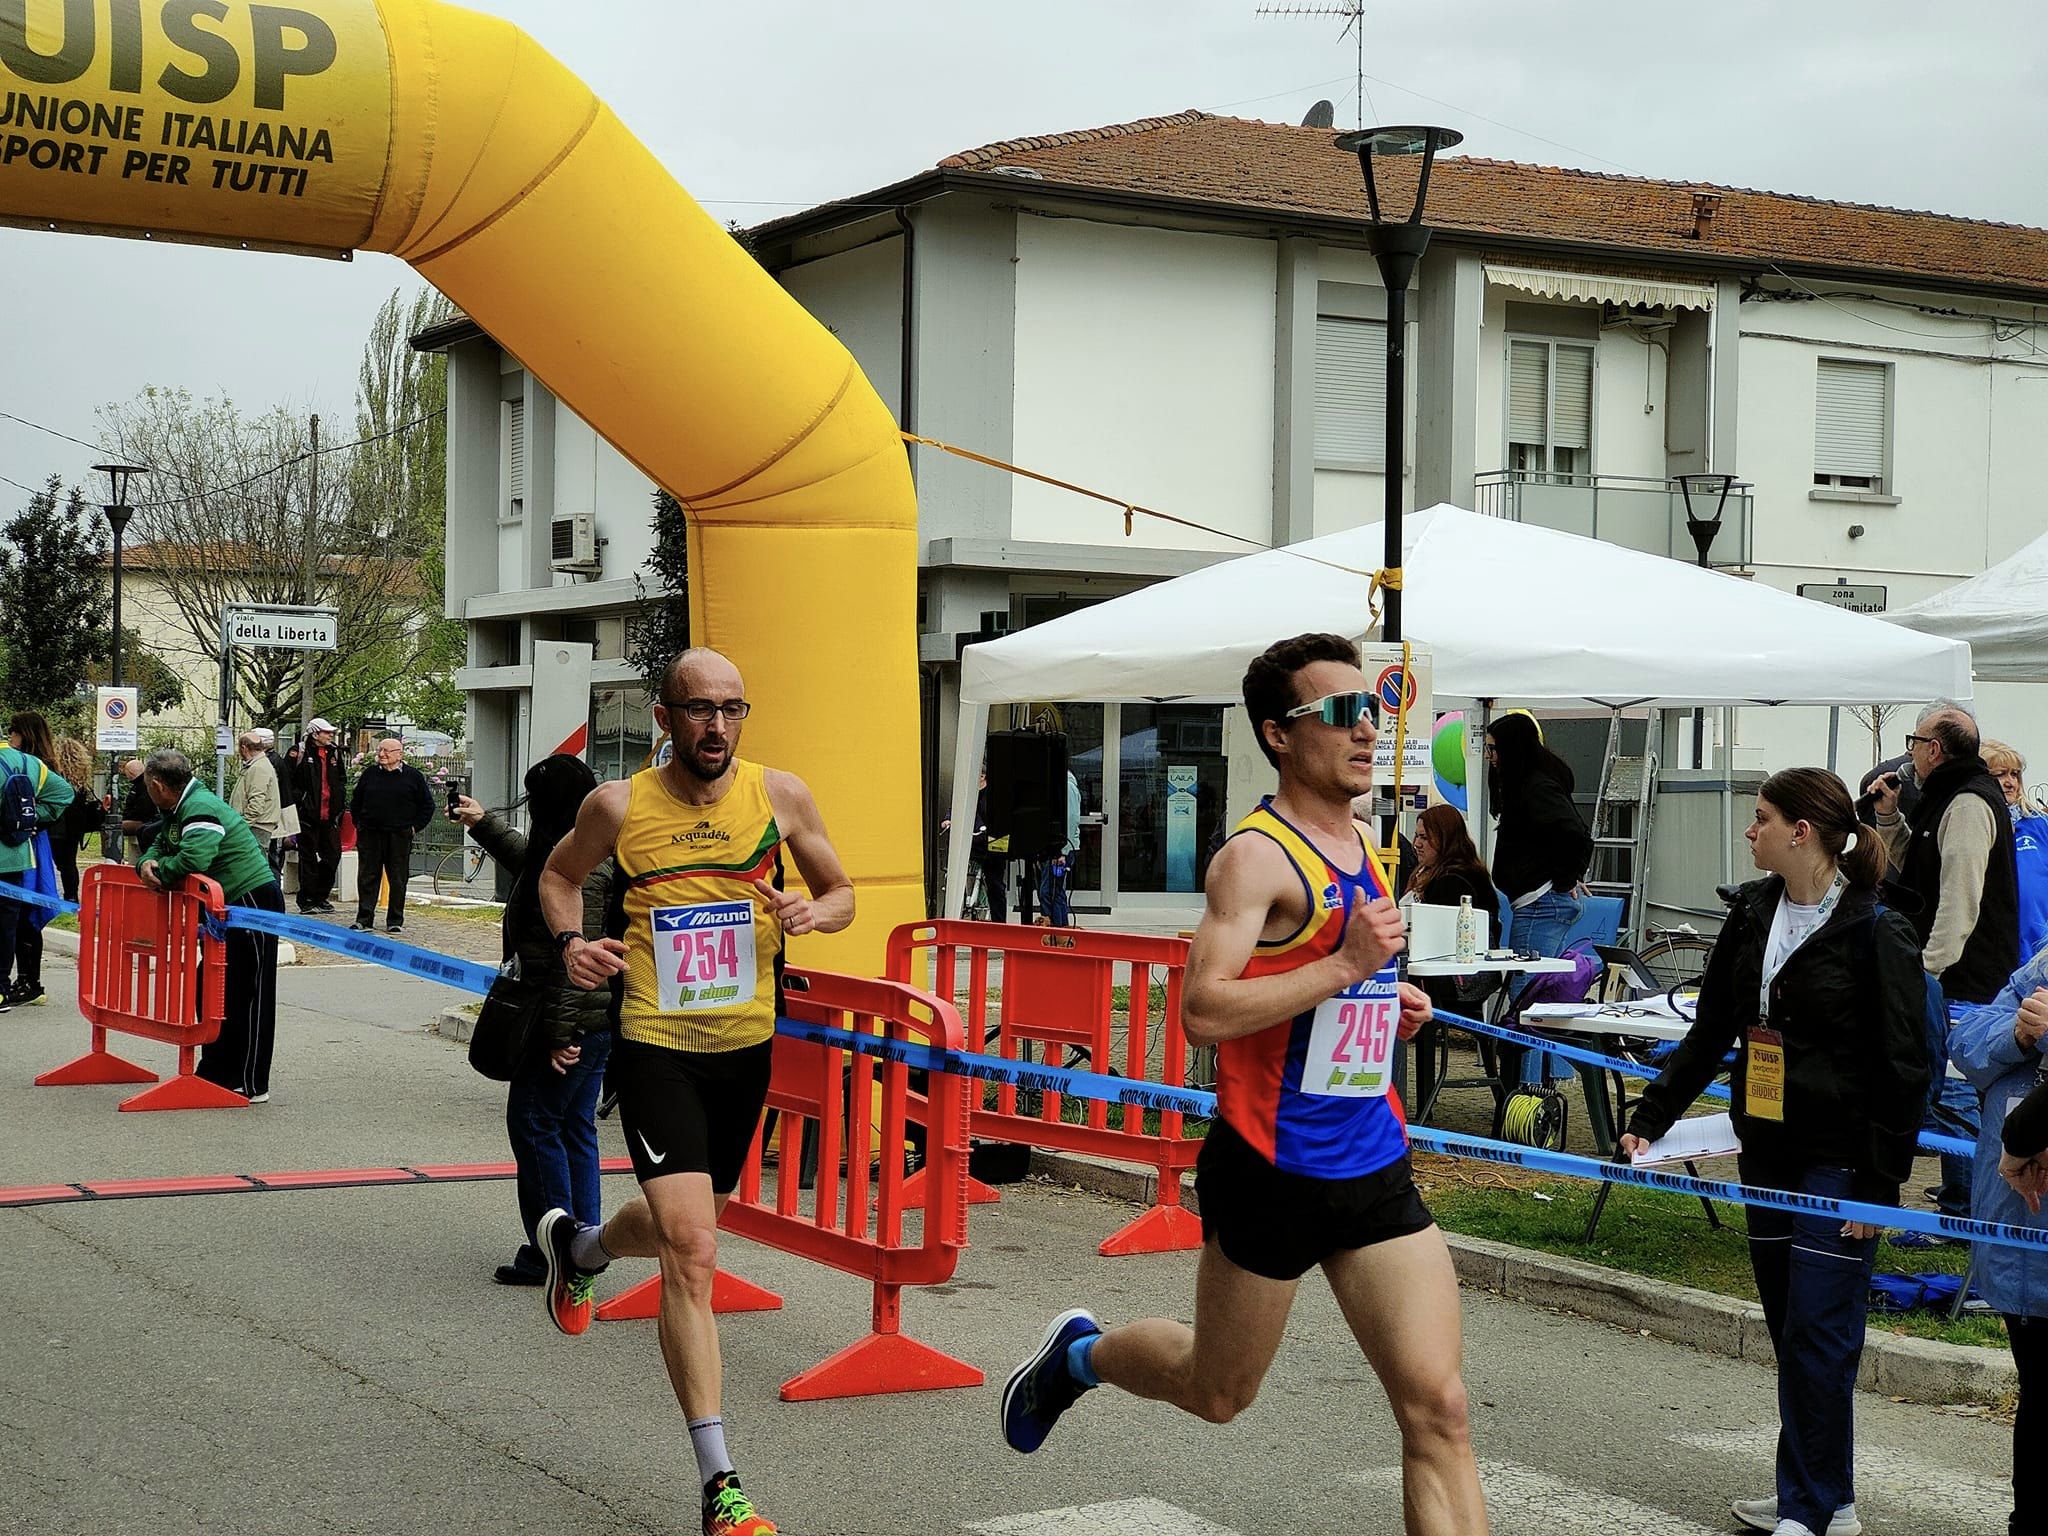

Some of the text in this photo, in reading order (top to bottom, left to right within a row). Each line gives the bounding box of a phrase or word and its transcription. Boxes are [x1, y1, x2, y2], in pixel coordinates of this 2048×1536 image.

[0, 0, 337, 111] UISP
[0, 92, 334, 163] UNIONE ITALIANA
[0, 134, 309, 197] PORT PER TUTTI
[1832, 590, 1855, 599] zona
[1844, 602, 1884, 613] limitato
[236, 624, 270, 638] della
[672, 928, 739, 983] 254
[1331, 1003, 1391, 1063] 245
[1761, 1051, 1779, 1064] UISP
[969, 1061, 1011, 1084] TUBAZIONI
[1015, 1071, 1071, 1093] ATTENZIONE
[1119, 1088, 1203, 1116] TUBAZIONI ACQUA
[1751, 1084, 1779, 1099] GIUDICE
[1739, 1186, 1841, 1213] ATTENZIONE
[1939, 1216, 1999, 1237] ACQUA
